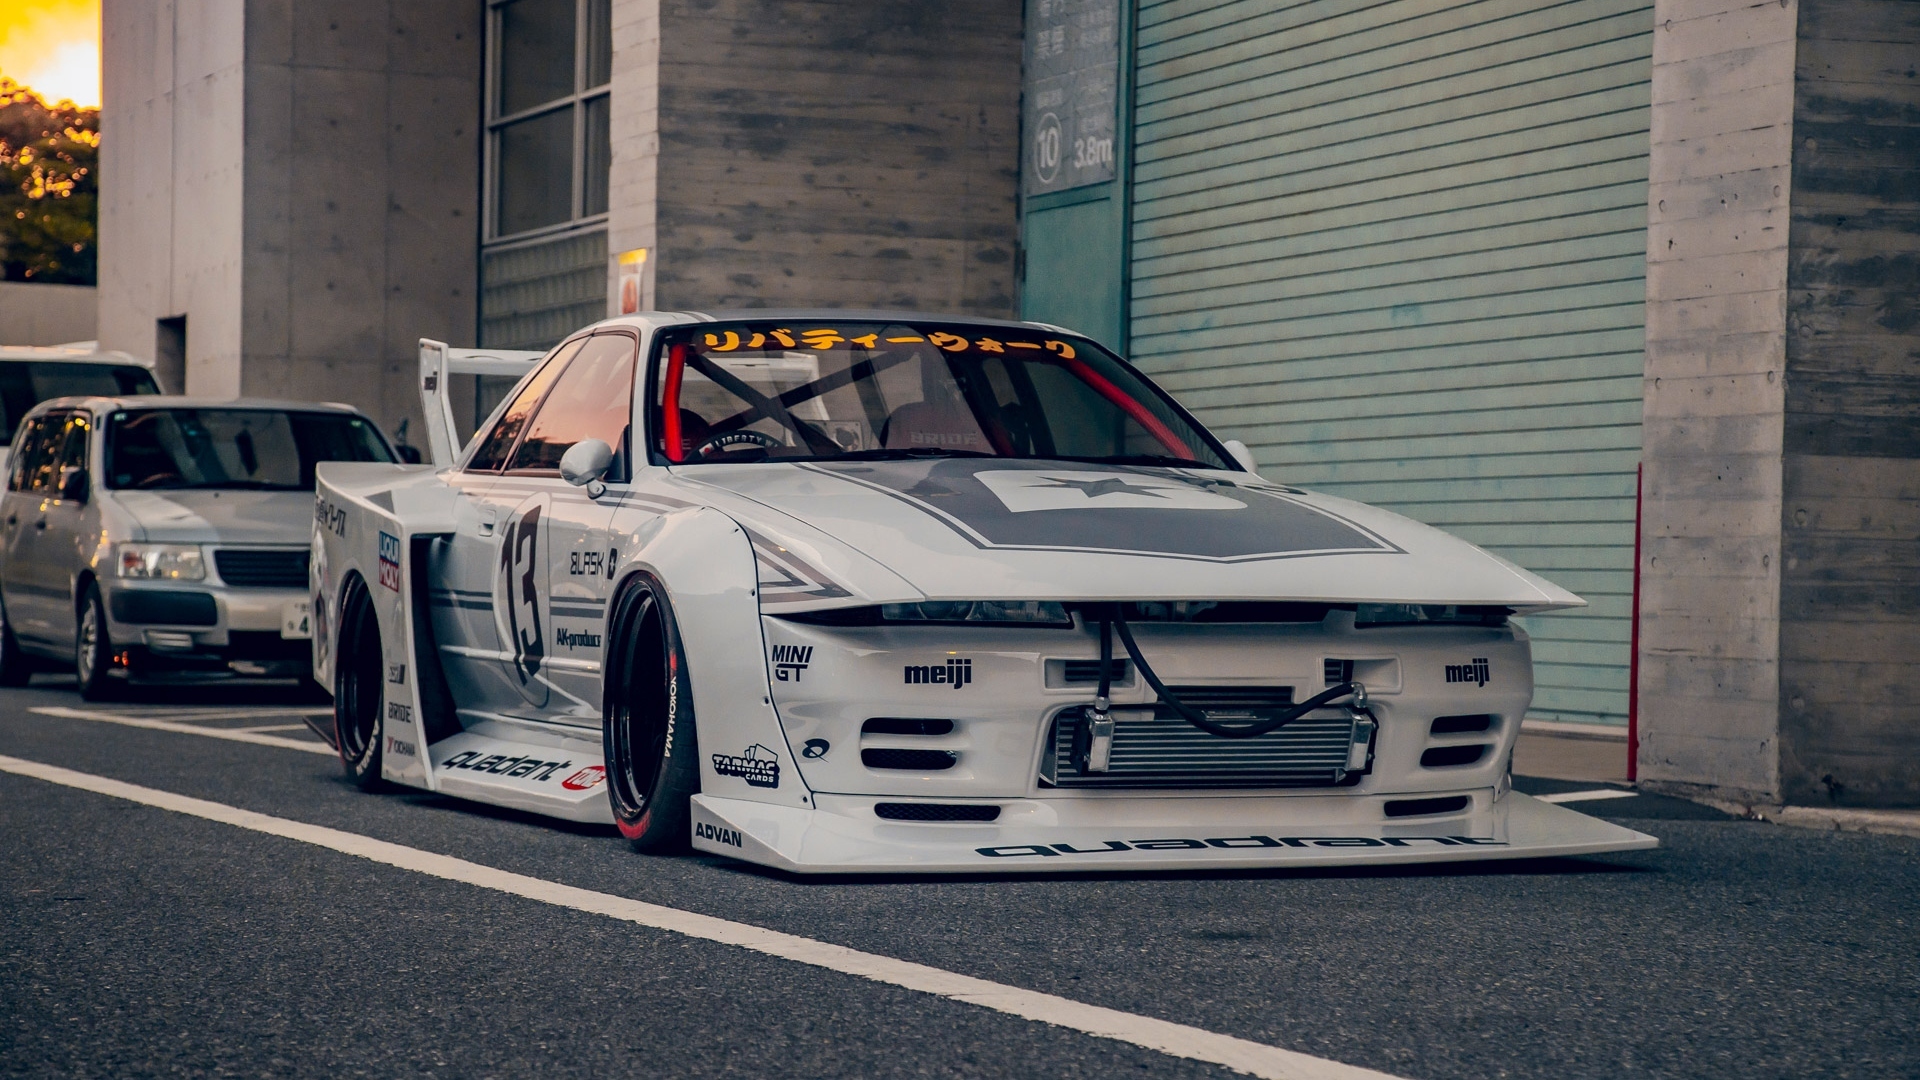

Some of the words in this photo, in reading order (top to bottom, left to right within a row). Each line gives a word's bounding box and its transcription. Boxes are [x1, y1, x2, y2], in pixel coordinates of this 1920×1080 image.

[1038, 126, 1059, 168] 10
[1074, 136, 1112, 169] 3.8m
[704, 328, 1076, 359] リバティーウォーク
[714, 434, 762, 447] LIBERTY
[910, 431, 977, 446] BRIDE
[380, 532, 399, 564] LIQUI
[379, 560, 399, 591] MOLY
[501, 504, 544, 686] 13
[772, 645, 814, 663] MINI
[775, 663, 809, 682] GT
[905, 658, 972, 690] meiji
[1445, 657, 1490, 688] meiji
[388, 702, 411, 723] BRIDE
[664, 676, 677, 758] YOKOHAMA
[441, 751, 573, 782] quadrant
[713, 754, 776, 775] TARMAC
[745, 773, 775, 783] CARDS
[695, 821, 742, 848] ADVAN
[975, 835, 1511, 858] quadrant
